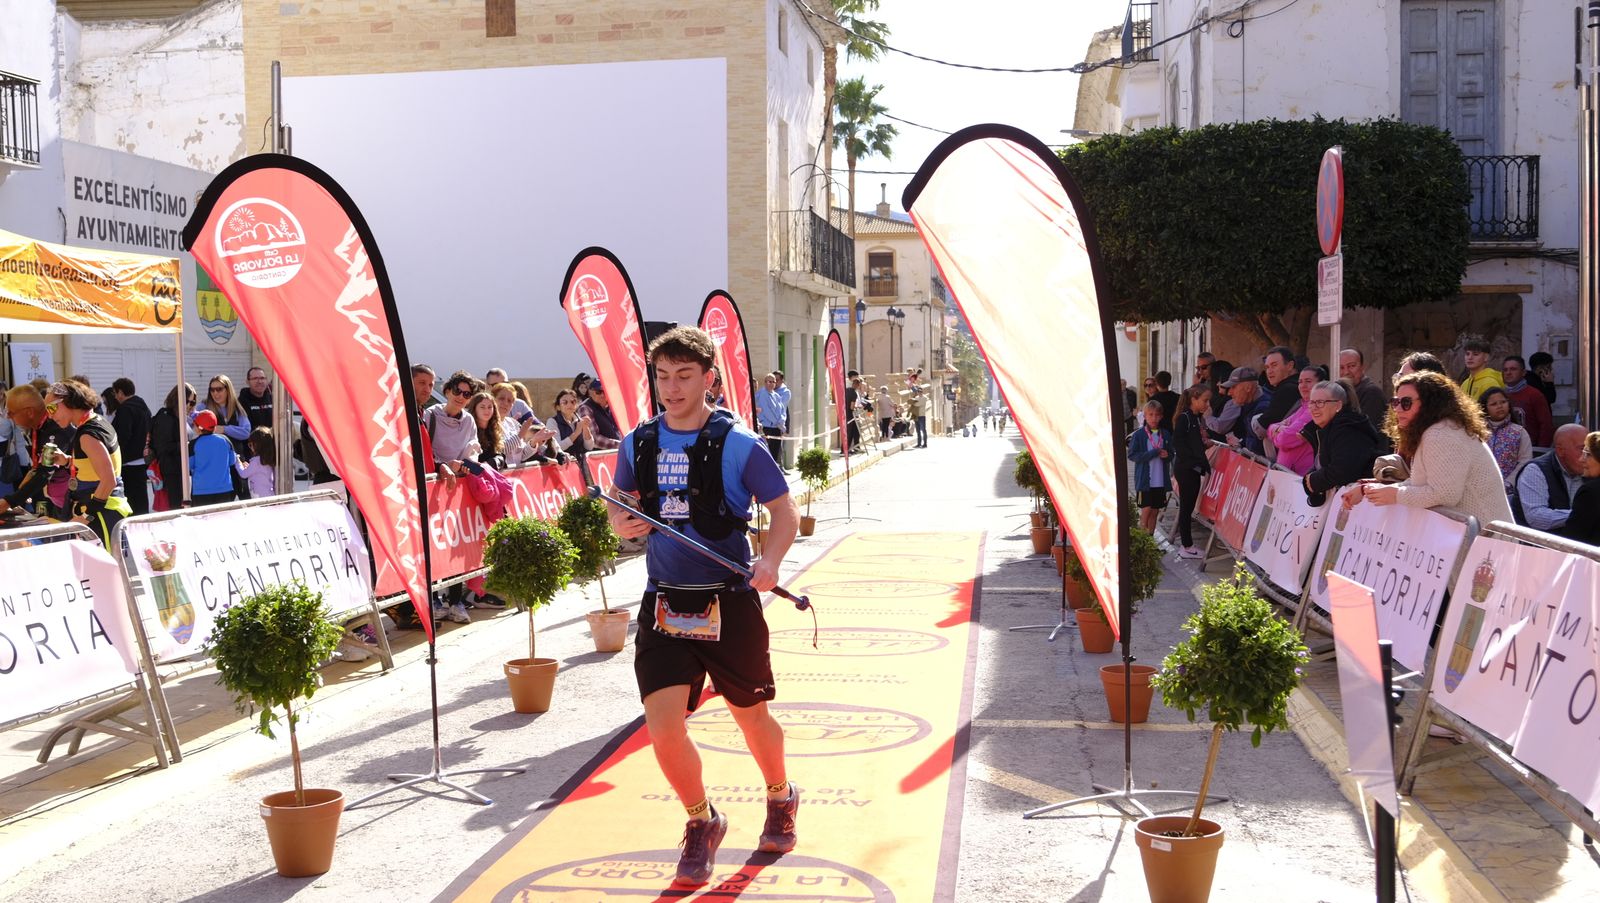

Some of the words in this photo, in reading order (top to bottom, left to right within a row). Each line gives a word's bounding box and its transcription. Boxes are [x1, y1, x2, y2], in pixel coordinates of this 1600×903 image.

[74, 175, 187, 218] EXCELENTÍSIMO
[667, 453, 690, 463] RUTA
[668, 476, 678, 484] DE
[193, 531, 322, 568] AYUNTAMIENTO
[327, 527, 348, 543] DE
[1426, 554, 1445, 579] DE
[64, 579, 94, 603] DE
[200, 548, 360, 612] CANTORIA
[1340, 547, 1436, 631] CANTORIA
[816, 787, 856, 797] de
[570, 867, 779, 885] POORA
[797, 875, 850, 888] LA
